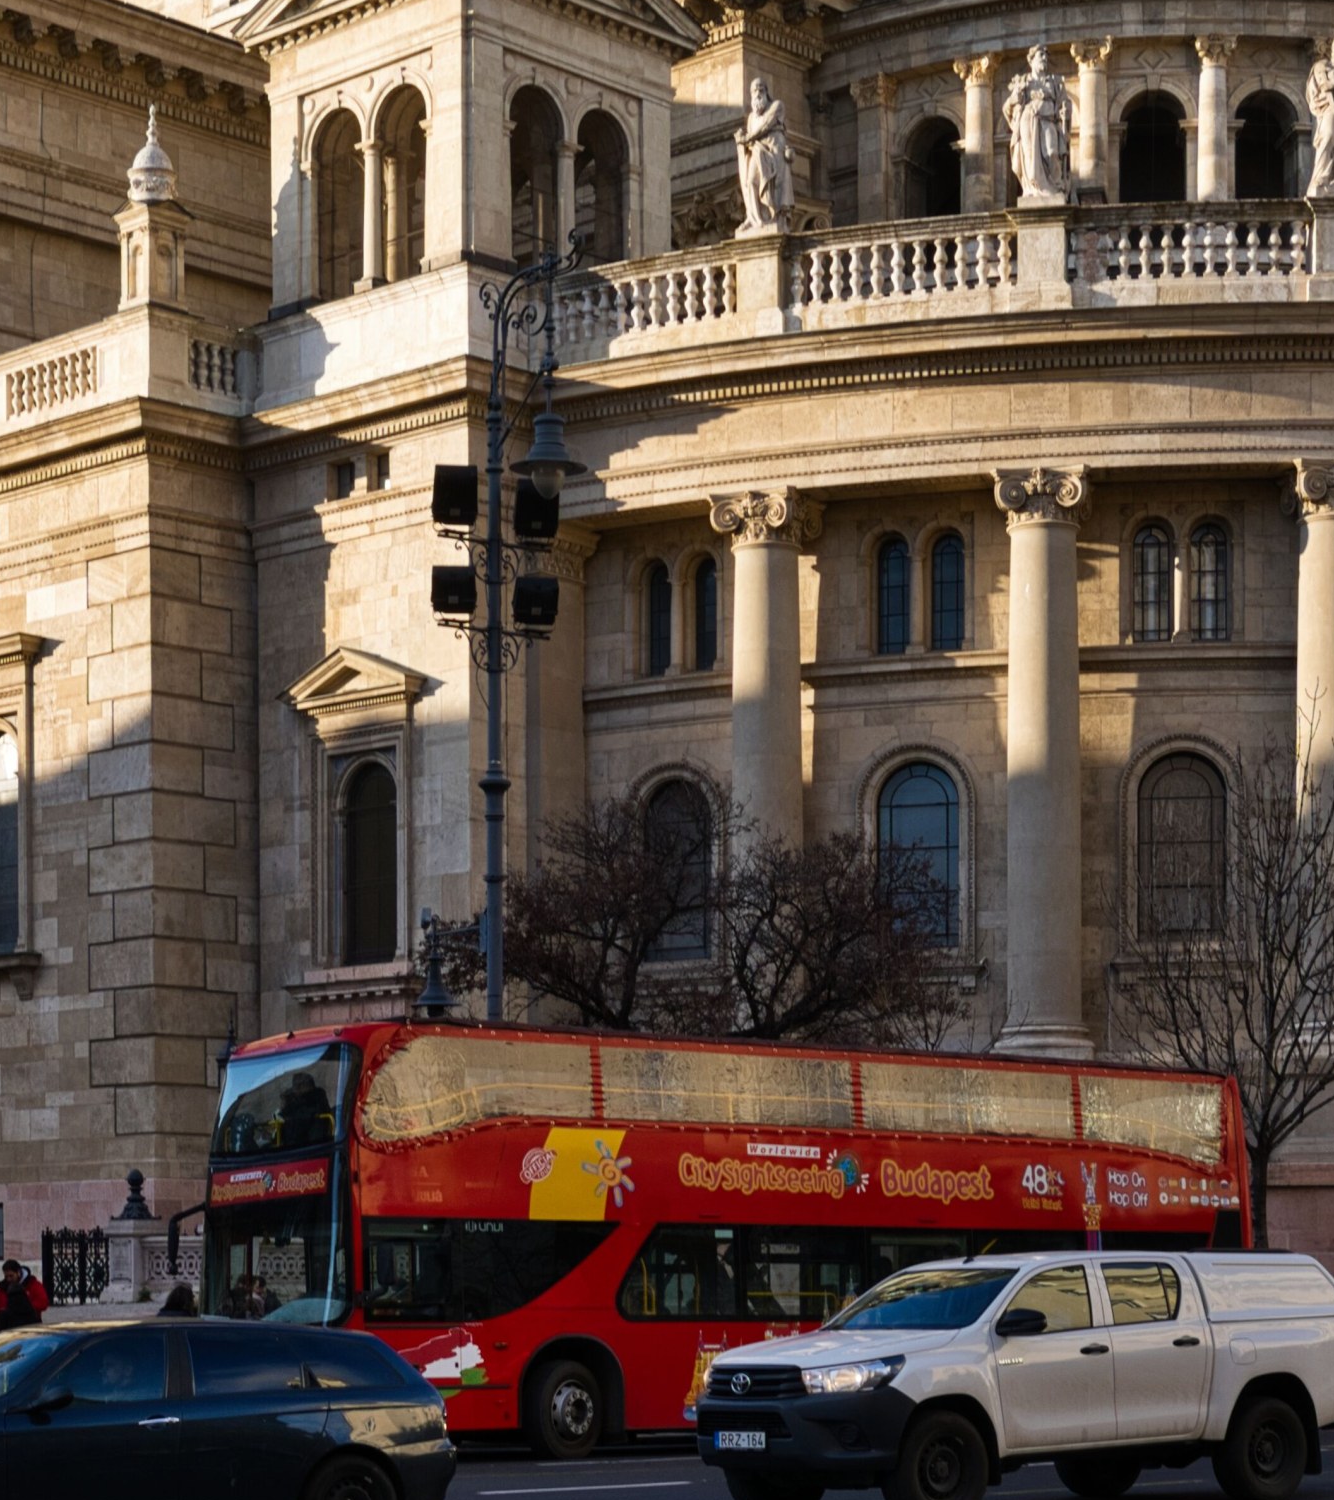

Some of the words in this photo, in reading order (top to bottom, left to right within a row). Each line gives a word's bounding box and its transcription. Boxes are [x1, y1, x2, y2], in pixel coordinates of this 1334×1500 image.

[749, 1145, 819, 1157] Worldwide
[678, 1152, 845, 1199] CitySightseeing
[881, 1158, 994, 1205] Budapest
[1021, 1164, 1048, 1195] 48
[1108, 1171, 1129, 1187] Hop
[1131, 1171, 1146, 1187] On
[1109, 1190, 1129, 1207] Hop
[1132, 1191, 1148, 1207] Off
[721, 1433, 763, 1447] RRZ-164
